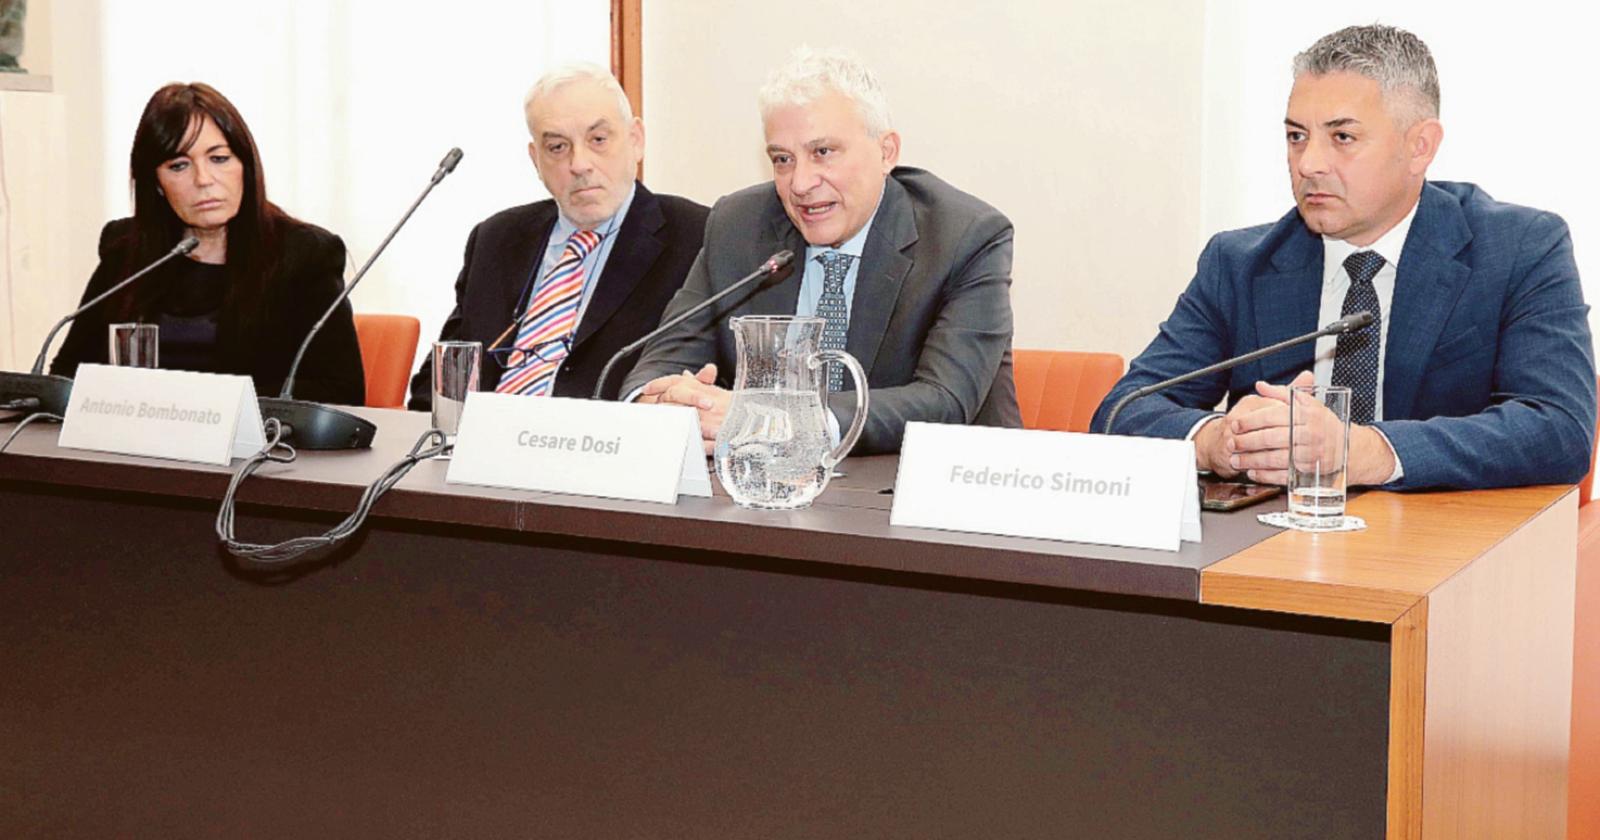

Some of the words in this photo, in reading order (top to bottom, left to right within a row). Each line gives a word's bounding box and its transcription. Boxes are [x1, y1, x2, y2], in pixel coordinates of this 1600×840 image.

[80, 398, 134, 417] Antonio
[137, 402, 221, 425] Bombonato
[517, 430, 577, 451] Cesare
[581, 435, 621, 455] Dosi
[950, 465, 1044, 489] Federico
[1050, 473, 1131, 496] Simoni
